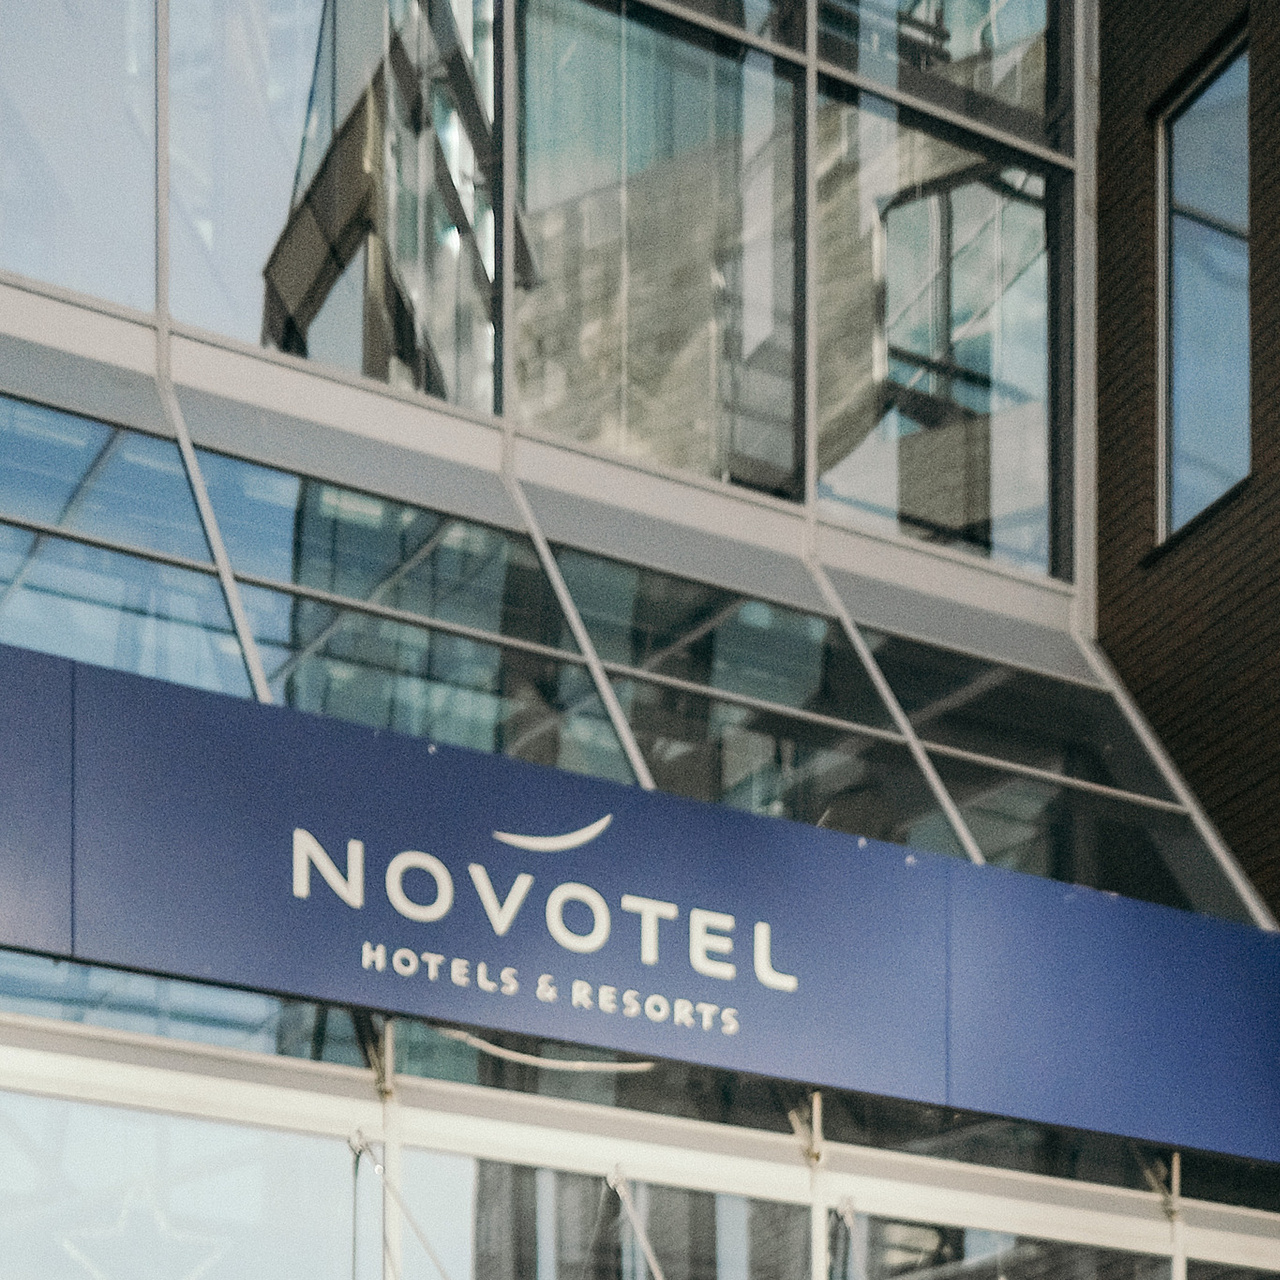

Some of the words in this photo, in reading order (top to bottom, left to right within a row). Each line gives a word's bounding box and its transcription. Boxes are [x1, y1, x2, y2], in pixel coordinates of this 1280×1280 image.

[292, 828, 798, 992] NOVOTEL
[361, 940, 519, 996] HOTELS
[535, 973, 559, 1002] &
[571, 979, 741, 1036] RESORTS
